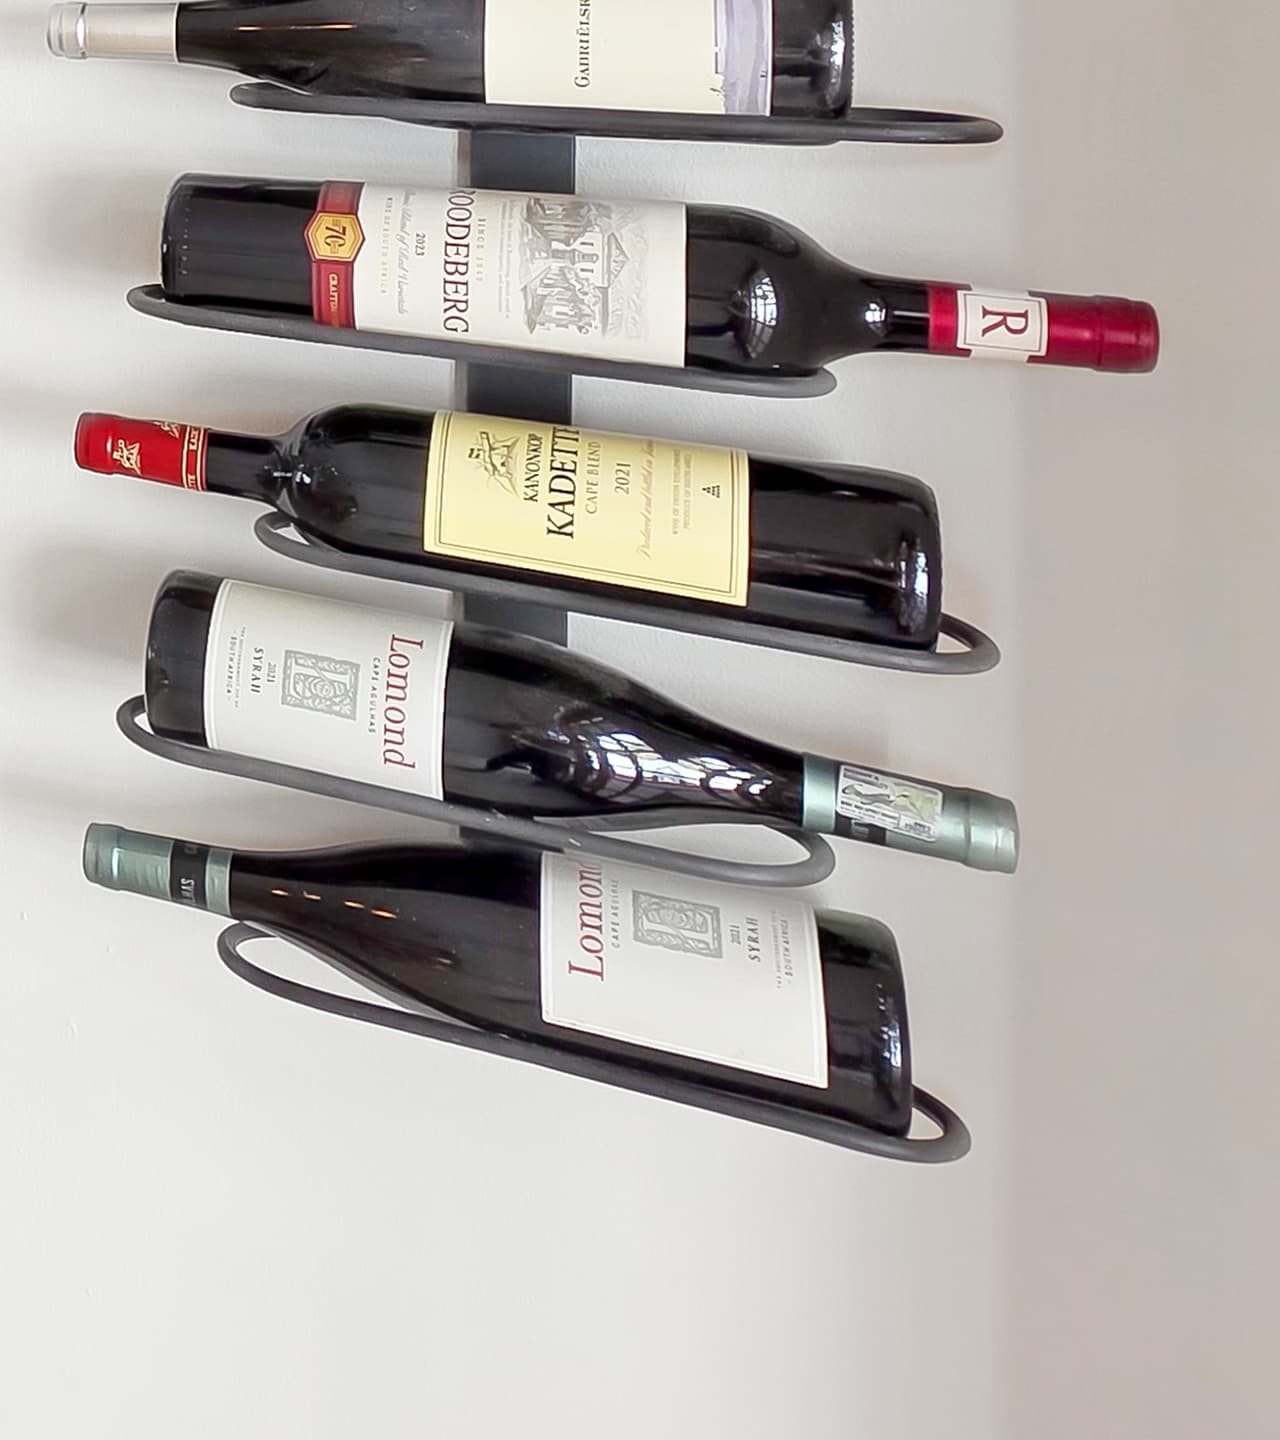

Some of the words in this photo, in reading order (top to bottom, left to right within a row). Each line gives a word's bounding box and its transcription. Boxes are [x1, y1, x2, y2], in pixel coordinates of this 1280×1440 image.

[414, 232, 426, 257] 2023
[980, 304, 1030, 338] R
[522, 432, 543, 503] KANONKOP
[586, 441, 601, 477] BLEND
[614, 462, 634, 496] 2021
[584, 480, 599, 515] CAPE
[250, 647, 265, 694] SYRAH
[370, 656, 382, 681] CAPE
[368, 686, 379, 734] AGULHAS
[382, 633, 424, 769] Lomond
[610, 921, 621, 948] CAPE
[745, 916, 761, 963] SYRAH
